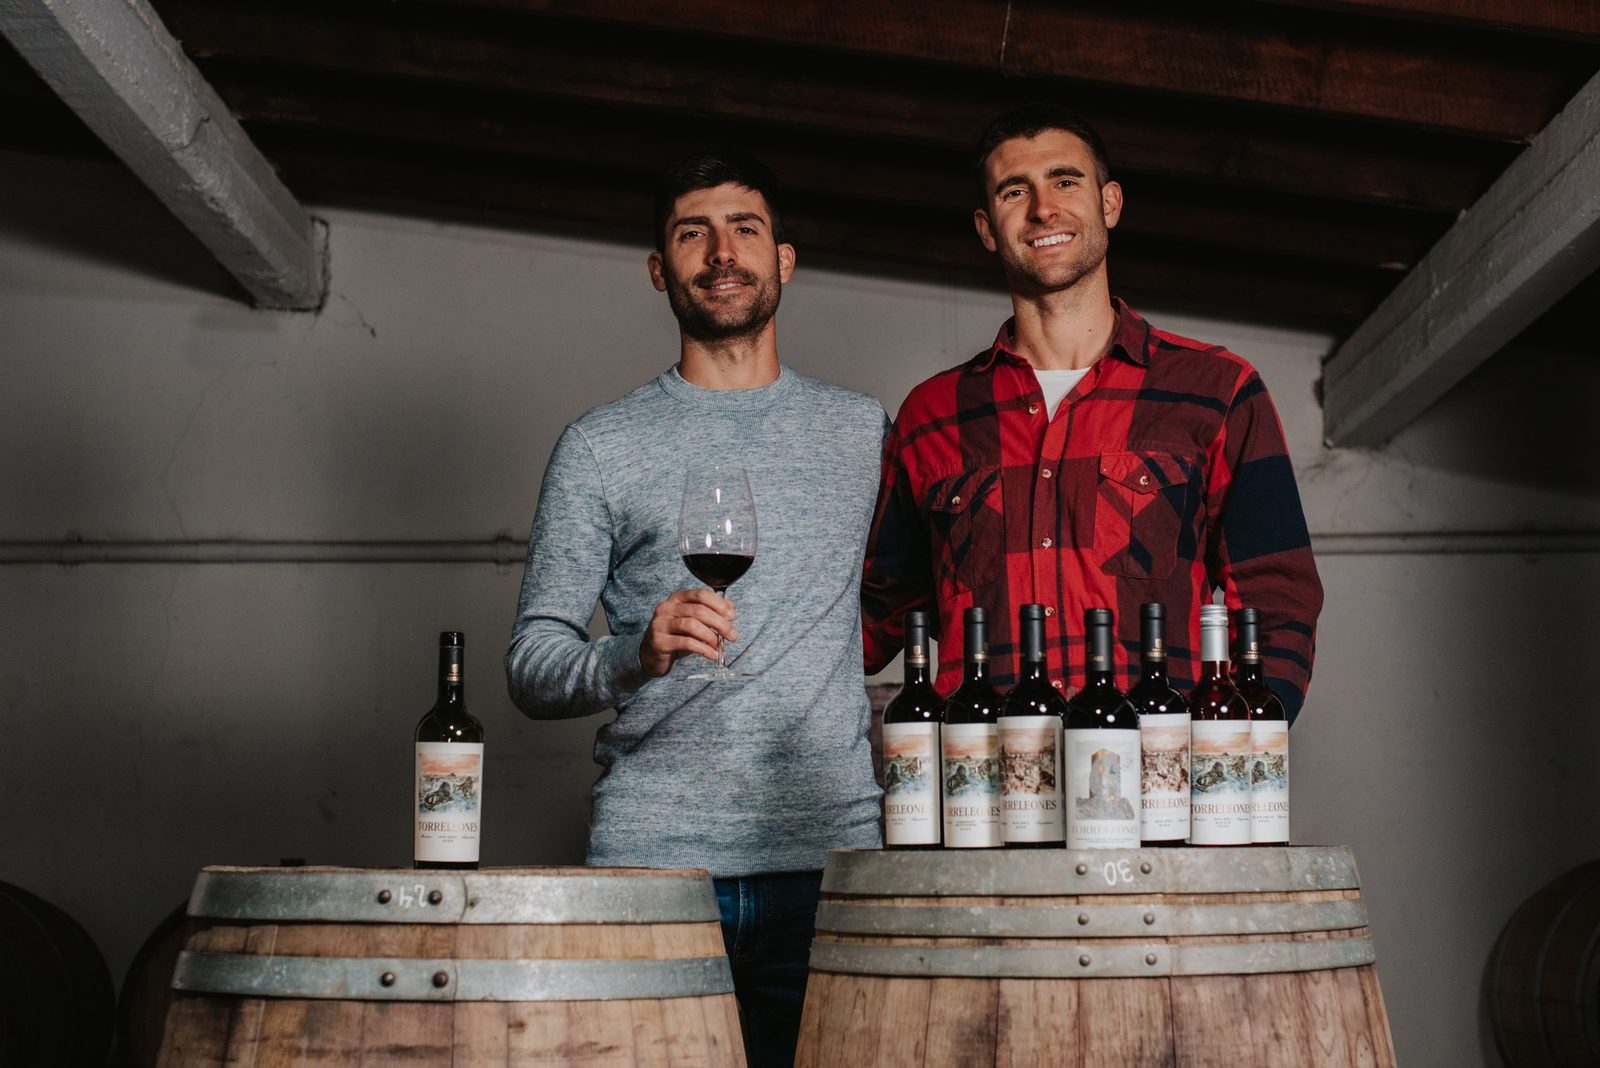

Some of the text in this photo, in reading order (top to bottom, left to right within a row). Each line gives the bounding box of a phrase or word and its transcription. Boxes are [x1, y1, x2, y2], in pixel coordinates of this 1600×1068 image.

[418, 821, 478, 832] TORRELONES
[1103, 859, 1134, 886] 30
[399, 884, 427, 909] 24
